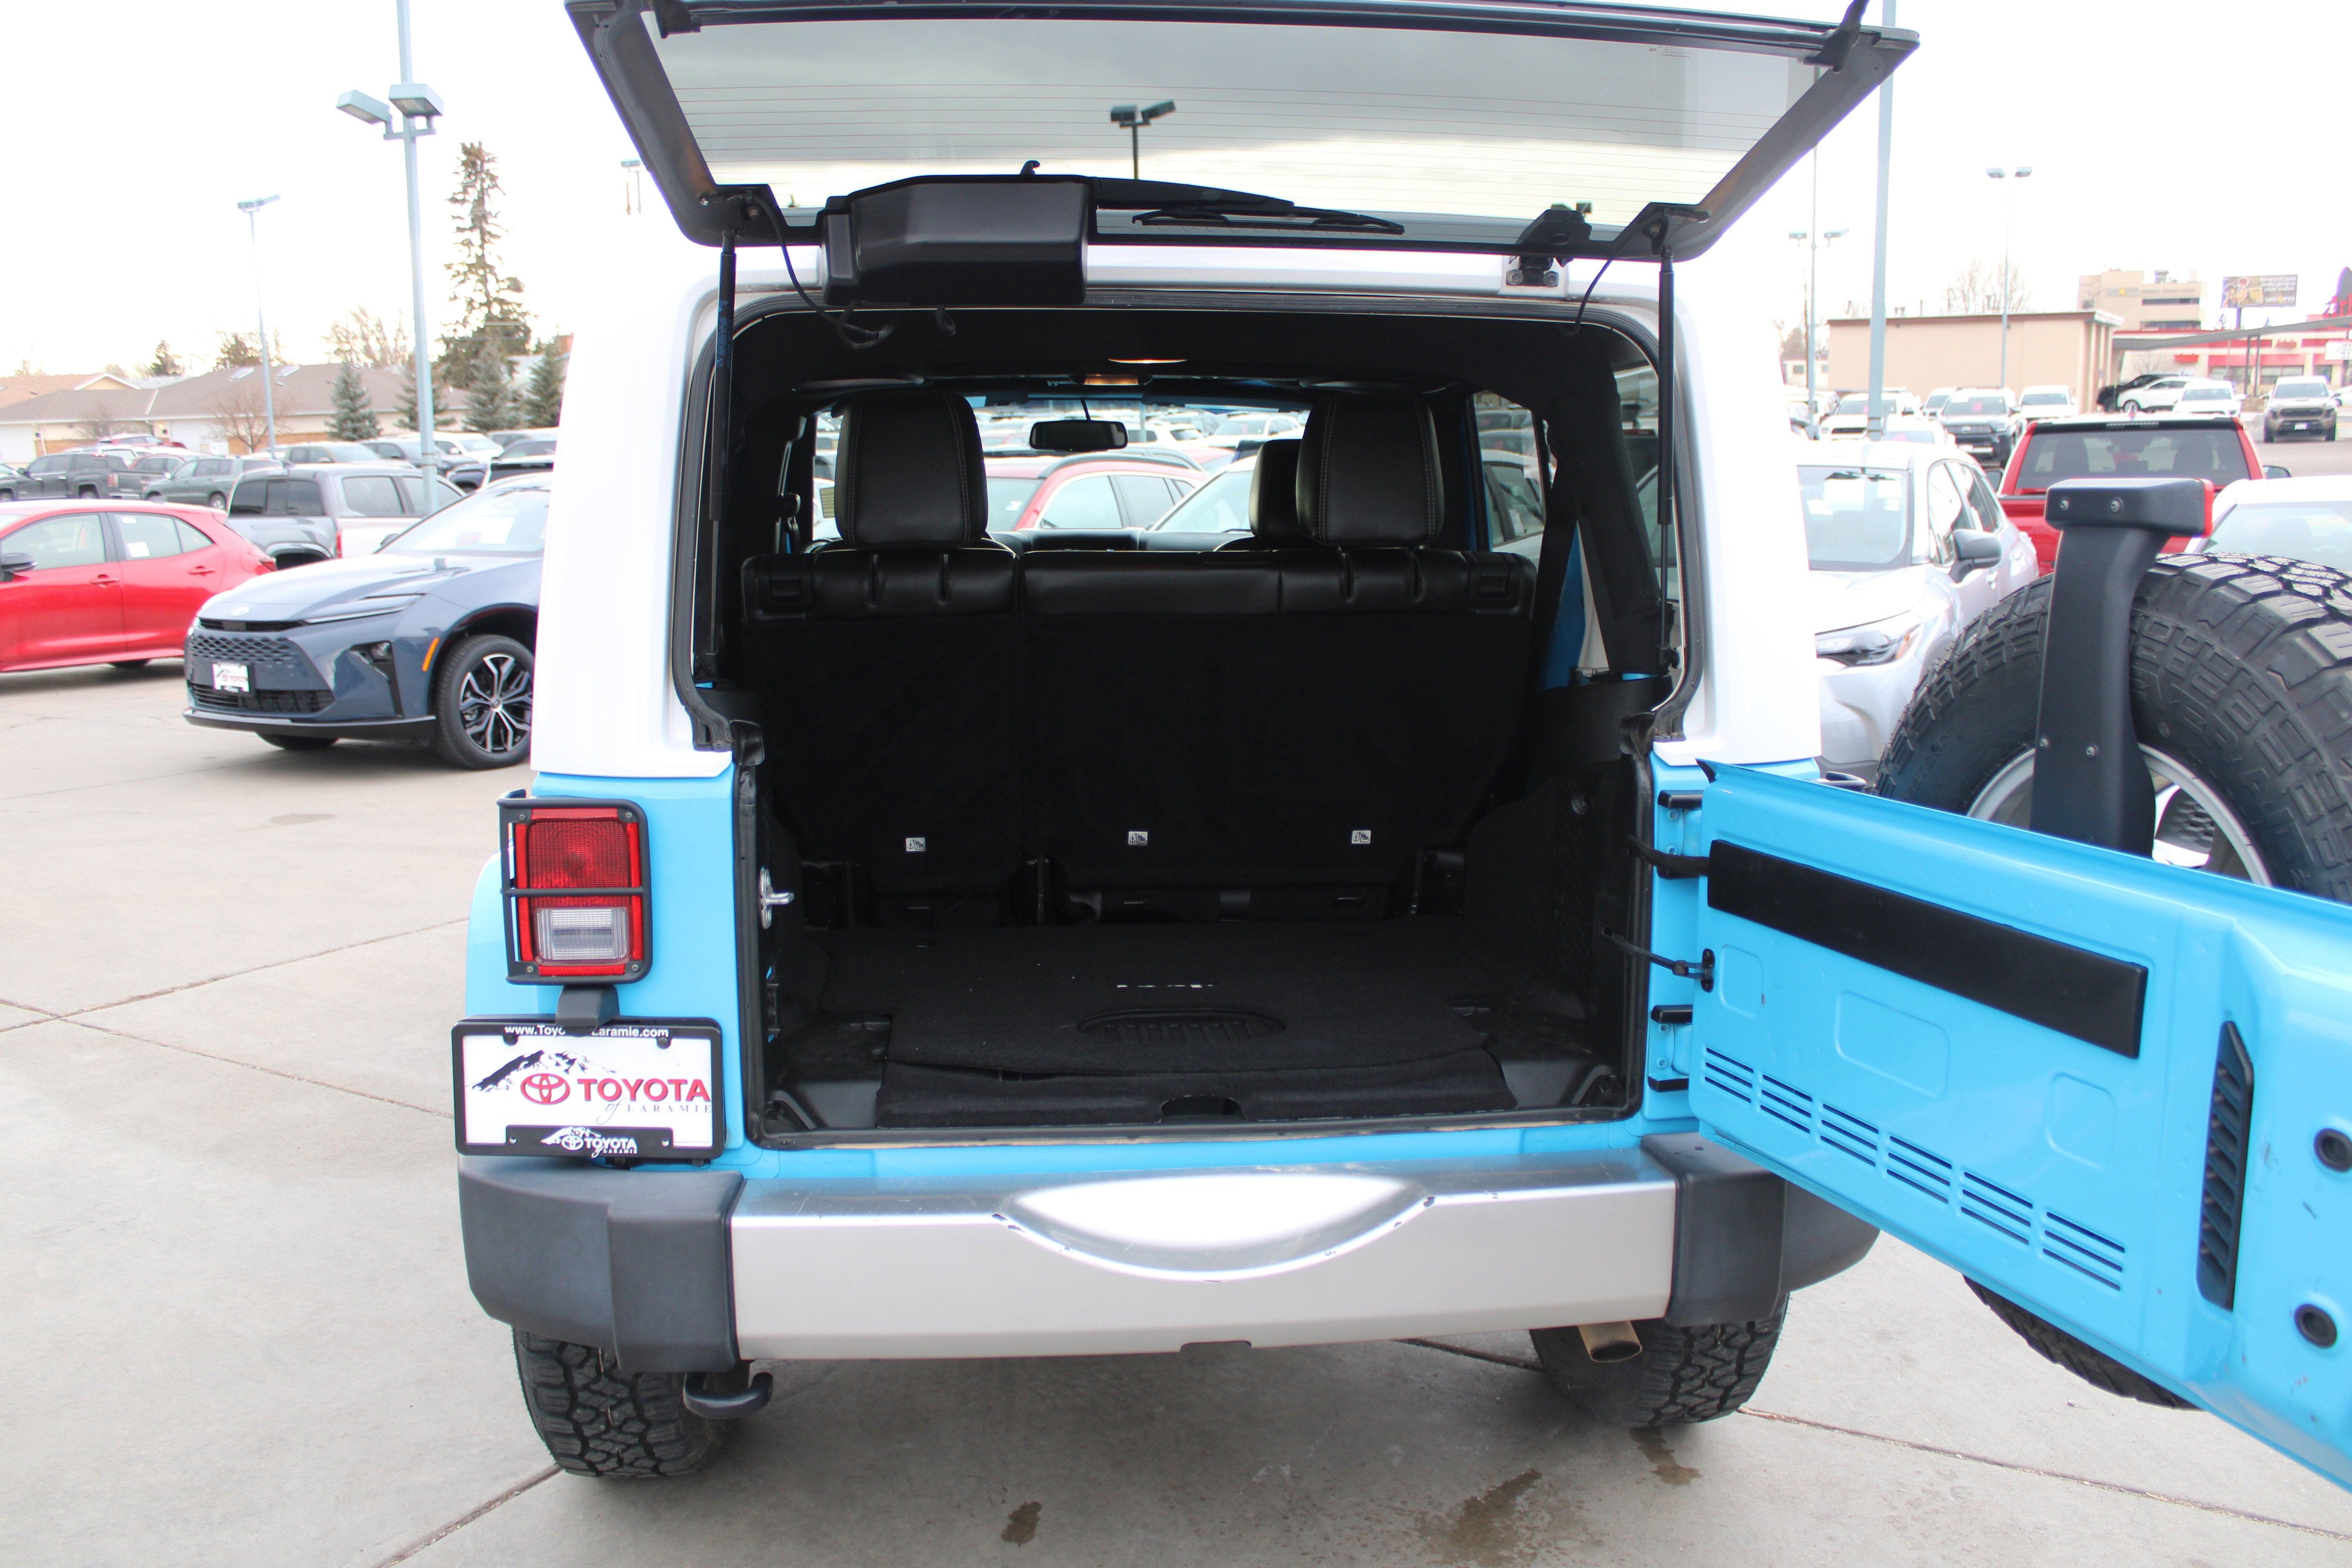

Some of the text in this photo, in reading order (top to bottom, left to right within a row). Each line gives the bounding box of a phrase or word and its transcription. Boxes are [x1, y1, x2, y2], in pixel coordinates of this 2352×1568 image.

[577, 1078, 711, 1102] TOYOTA
[596, 1098, 711, 1125] of LARAMIE
[584, 1137, 638, 1149] TOYOTA
[591, 1147, 604, 1158] of
